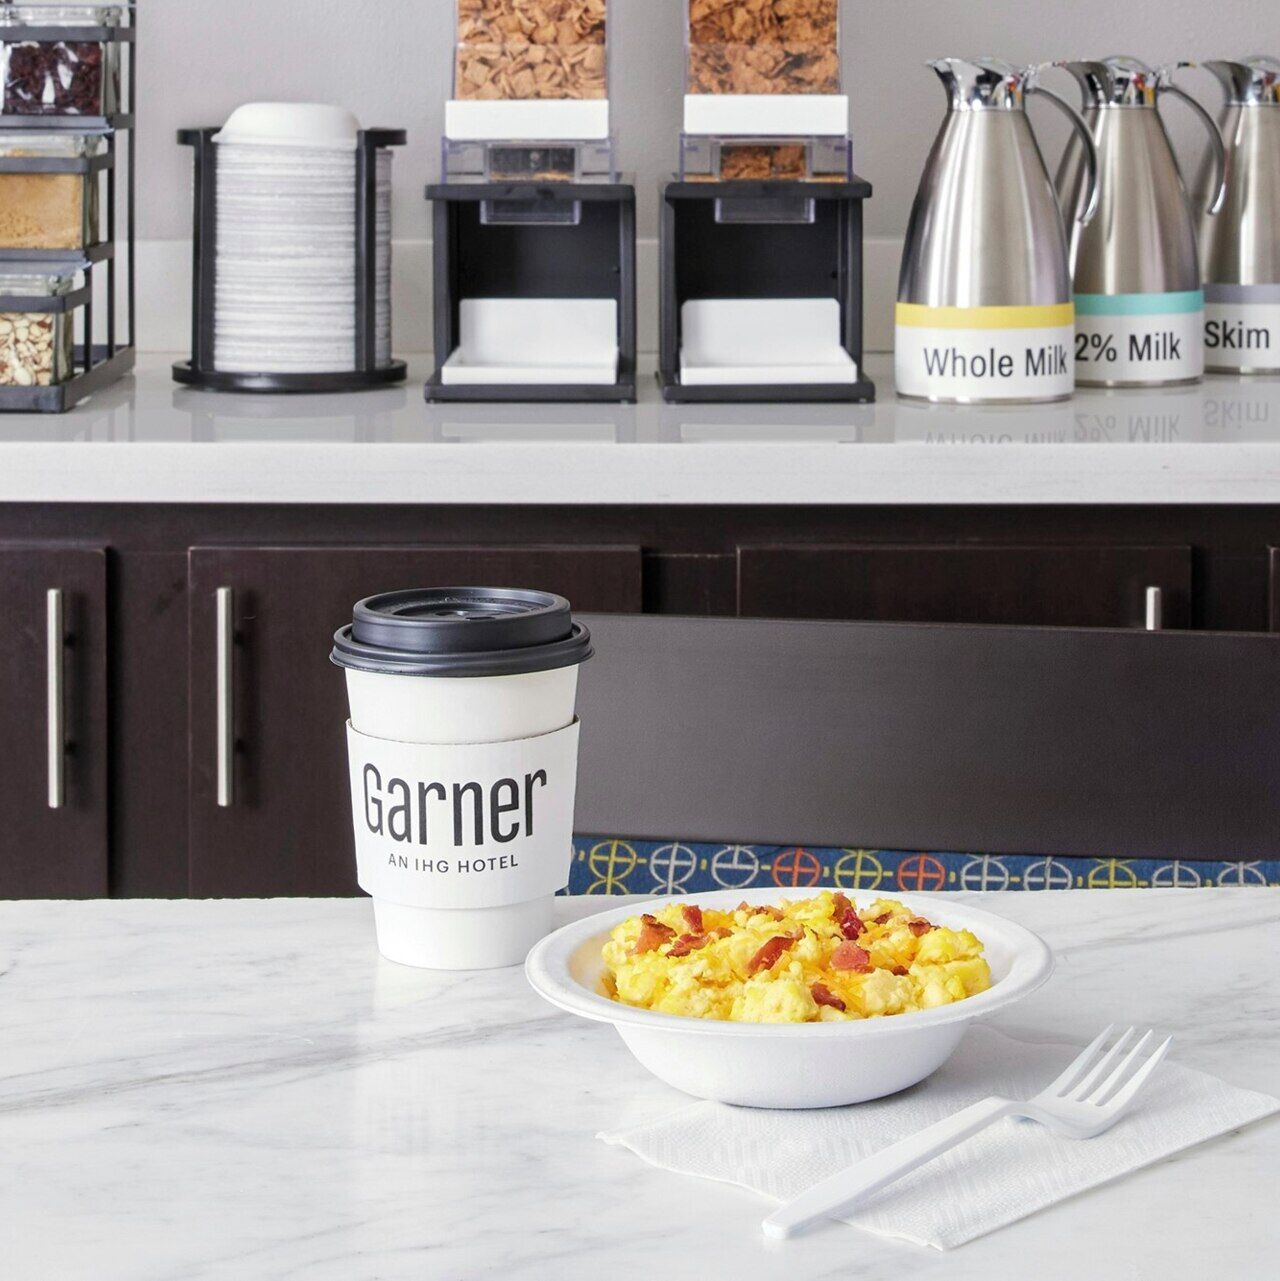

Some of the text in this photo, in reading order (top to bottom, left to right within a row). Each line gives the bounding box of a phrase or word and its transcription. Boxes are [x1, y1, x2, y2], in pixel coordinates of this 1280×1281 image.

[1074, 331, 1181, 363] 2% Milk
[1204, 320, 1270, 349] Skim
[923, 344, 1068, 378] Whole Milk
[363, 763, 547, 846] Garner
[388, 853, 519, 873] AN IHG HOTEL
